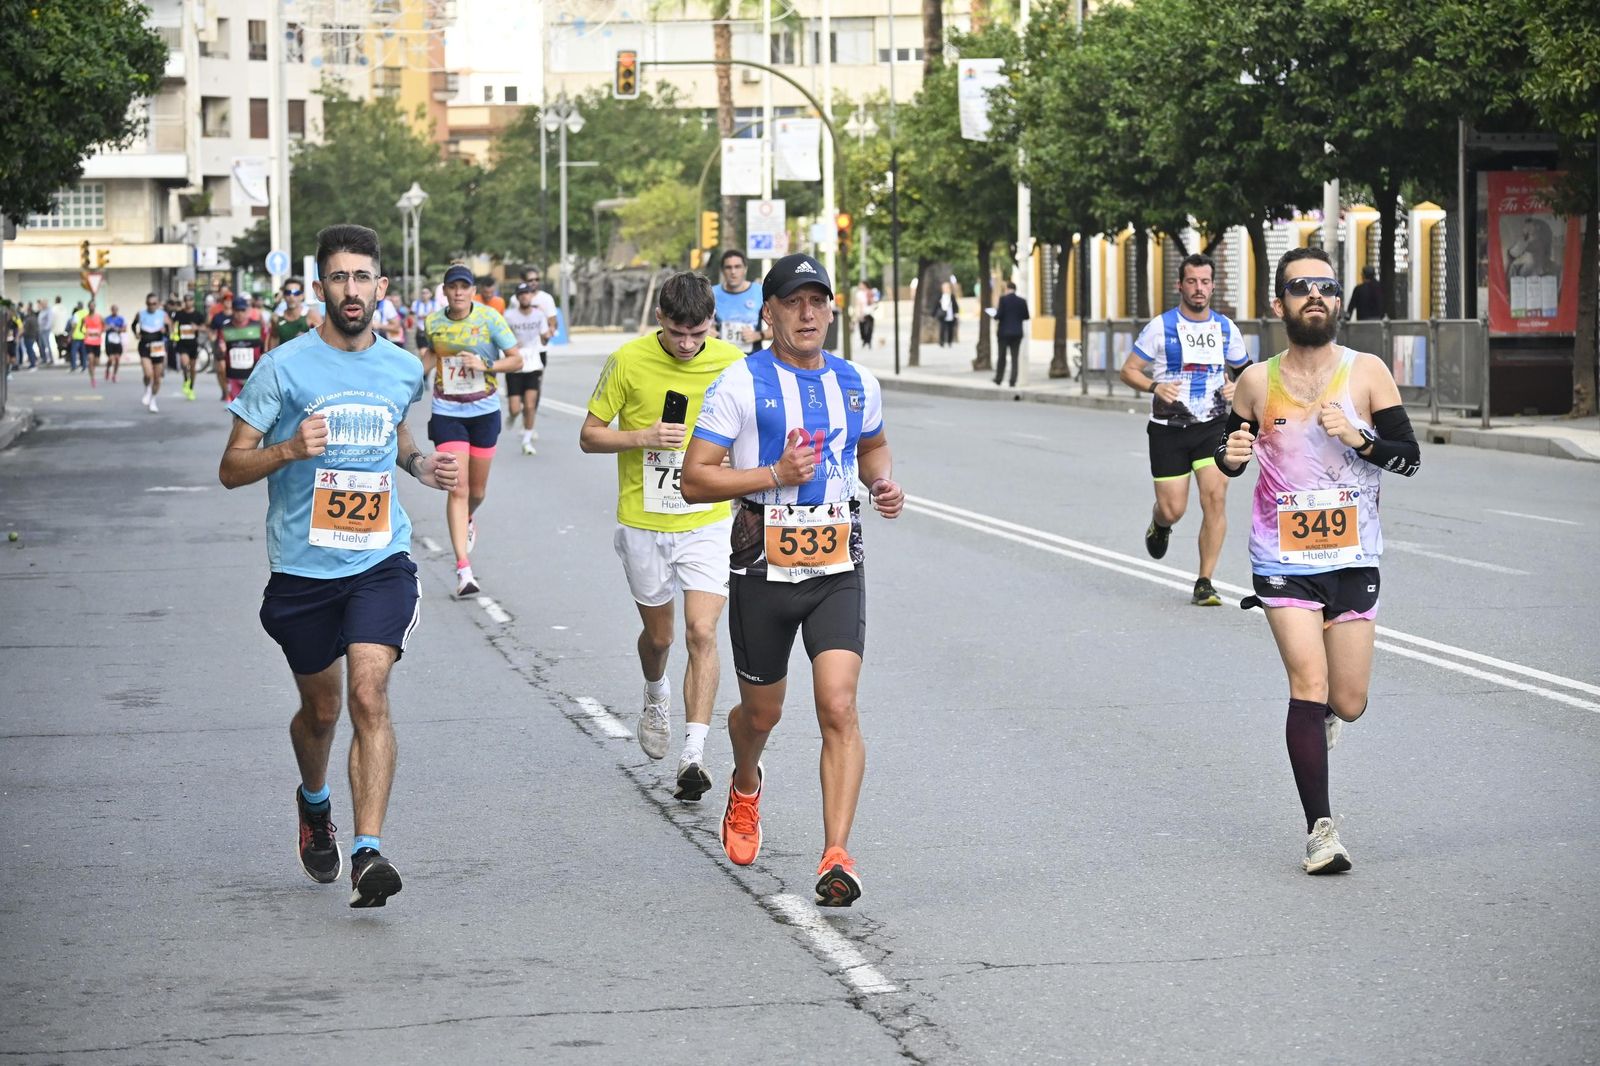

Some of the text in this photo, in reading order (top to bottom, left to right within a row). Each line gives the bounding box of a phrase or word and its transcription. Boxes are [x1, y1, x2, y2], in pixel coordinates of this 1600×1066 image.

[1186, 333, 1216, 348] 946
[448, 365, 475, 380] 741
[303, 395, 326, 415] XLIII
[326, 392, 342, 401] GRAN
[655, 467, 683, 491] 75
[327, 491, 381, 521] 523
[1291, 509, 1347, 539] 349
[333, 531, 368, 544] Huelva
[779, 526, 837, 556] 533
[1302, 550, 1338, 560] Huelva
[789, 567, 826, 577] Huelva
